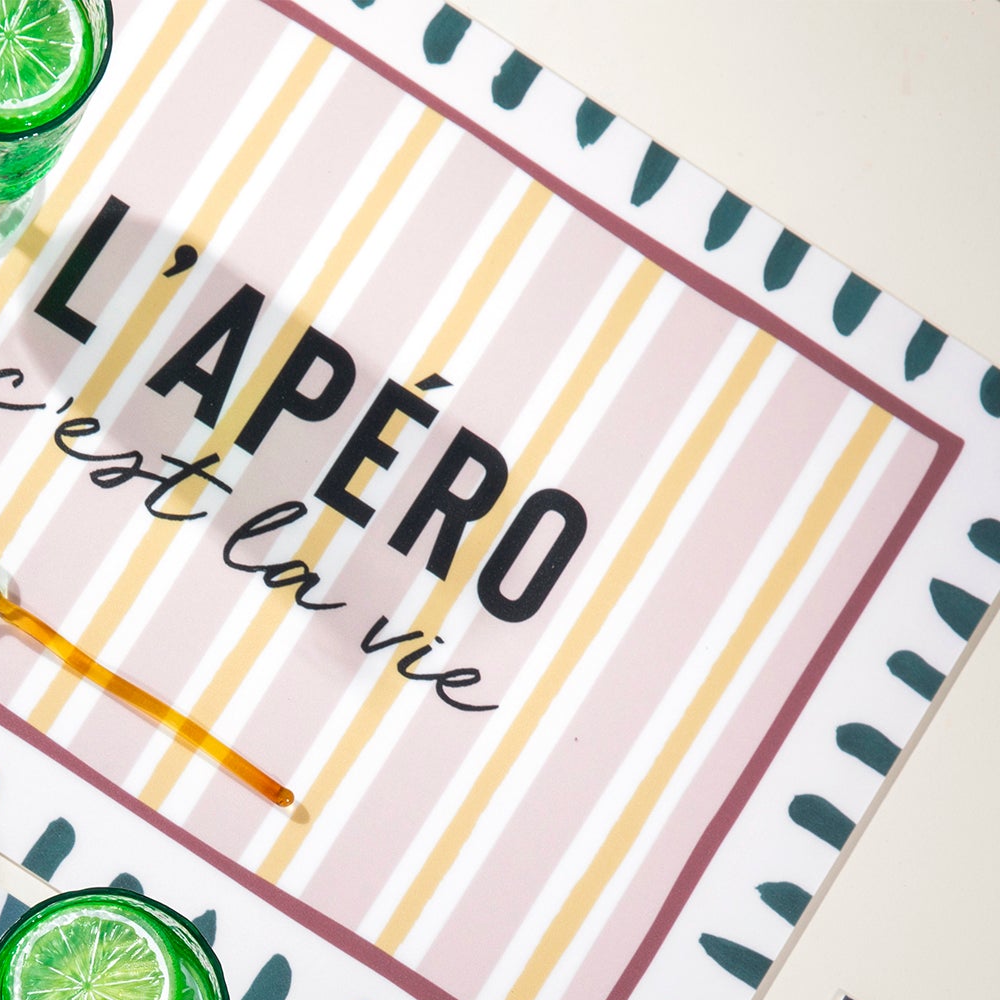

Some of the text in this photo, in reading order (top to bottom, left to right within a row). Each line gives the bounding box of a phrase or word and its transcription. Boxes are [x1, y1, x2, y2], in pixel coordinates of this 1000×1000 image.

[35, 195, 588, 623] L'APÉRO
[223, 500, 347, 610] la
[361, 615, 499, 712] vie
